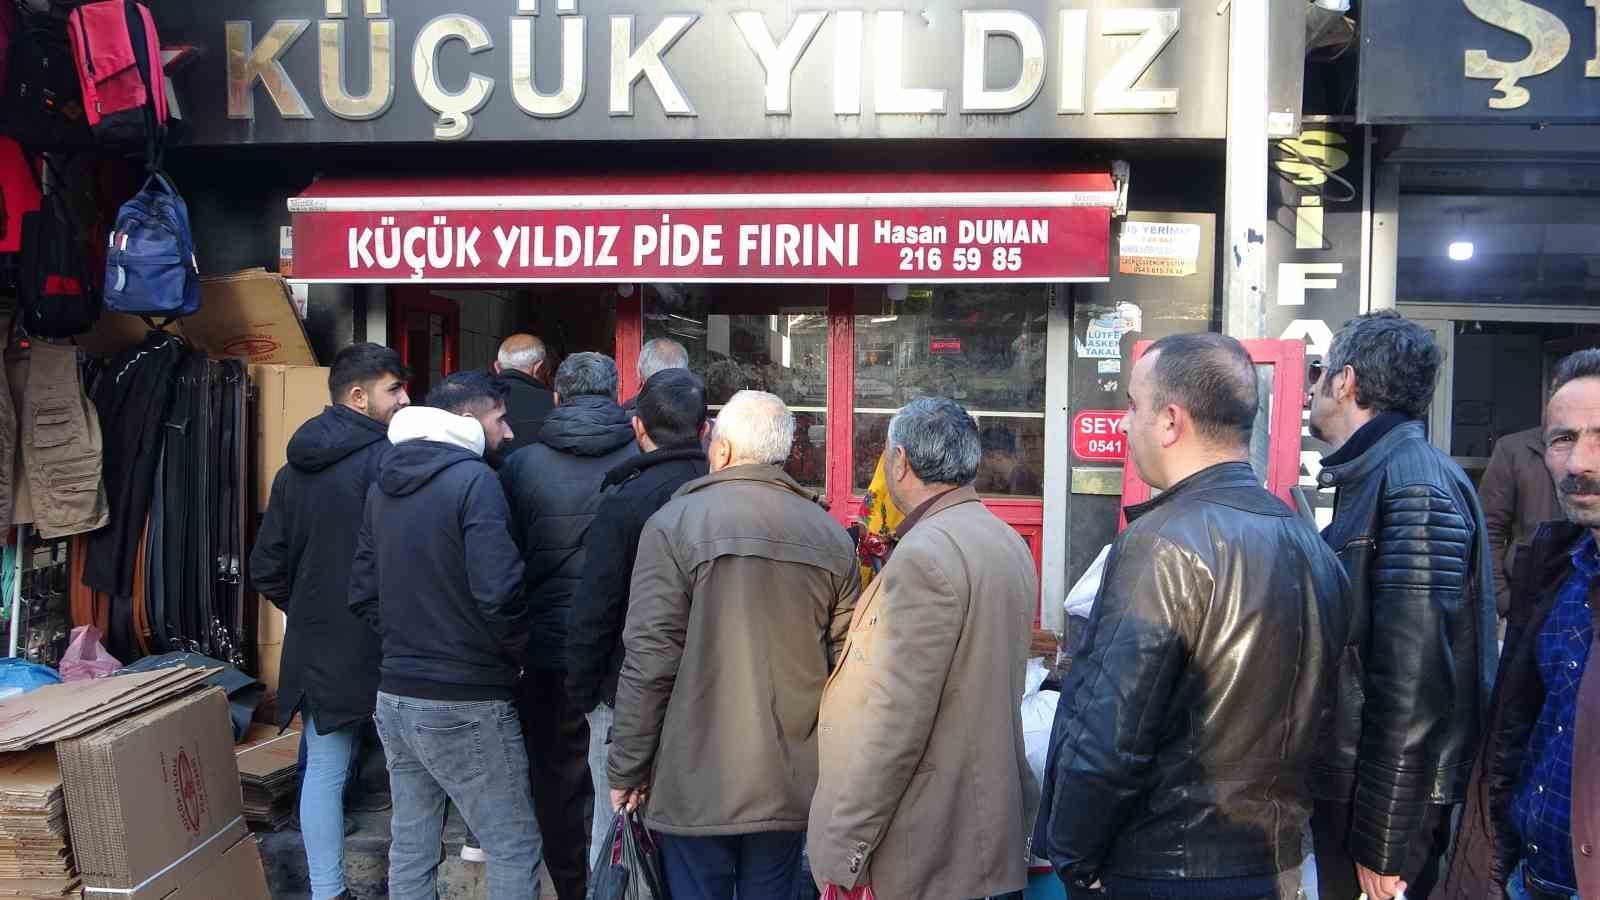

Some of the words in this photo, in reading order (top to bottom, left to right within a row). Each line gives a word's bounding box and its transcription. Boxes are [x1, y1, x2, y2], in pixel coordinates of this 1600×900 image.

[225, 0, 701, 141] KÜÇÜK
[733, 7, 1181, 116] YILDIZ
[873, 219, 947, 245] Hasan
[958, 219, 1049, 245] DUMAN
[348, 216, 482, 279] KÜÇÜK
[492, 224, 621, 269] YILDIZ
[632, 213, 724, 267] PİDE
[738, 223, 859, 268] FIRINI
[899, 247, 942, 271] 216
[952, 248, 982, 271] 59
[991, 248, 1022, 271] 85
[1088, 330, 1121, 339] LÜTFE
[1080, 416, 1121, 435] SEY
[1088, 439, 1121, 453] 0541
